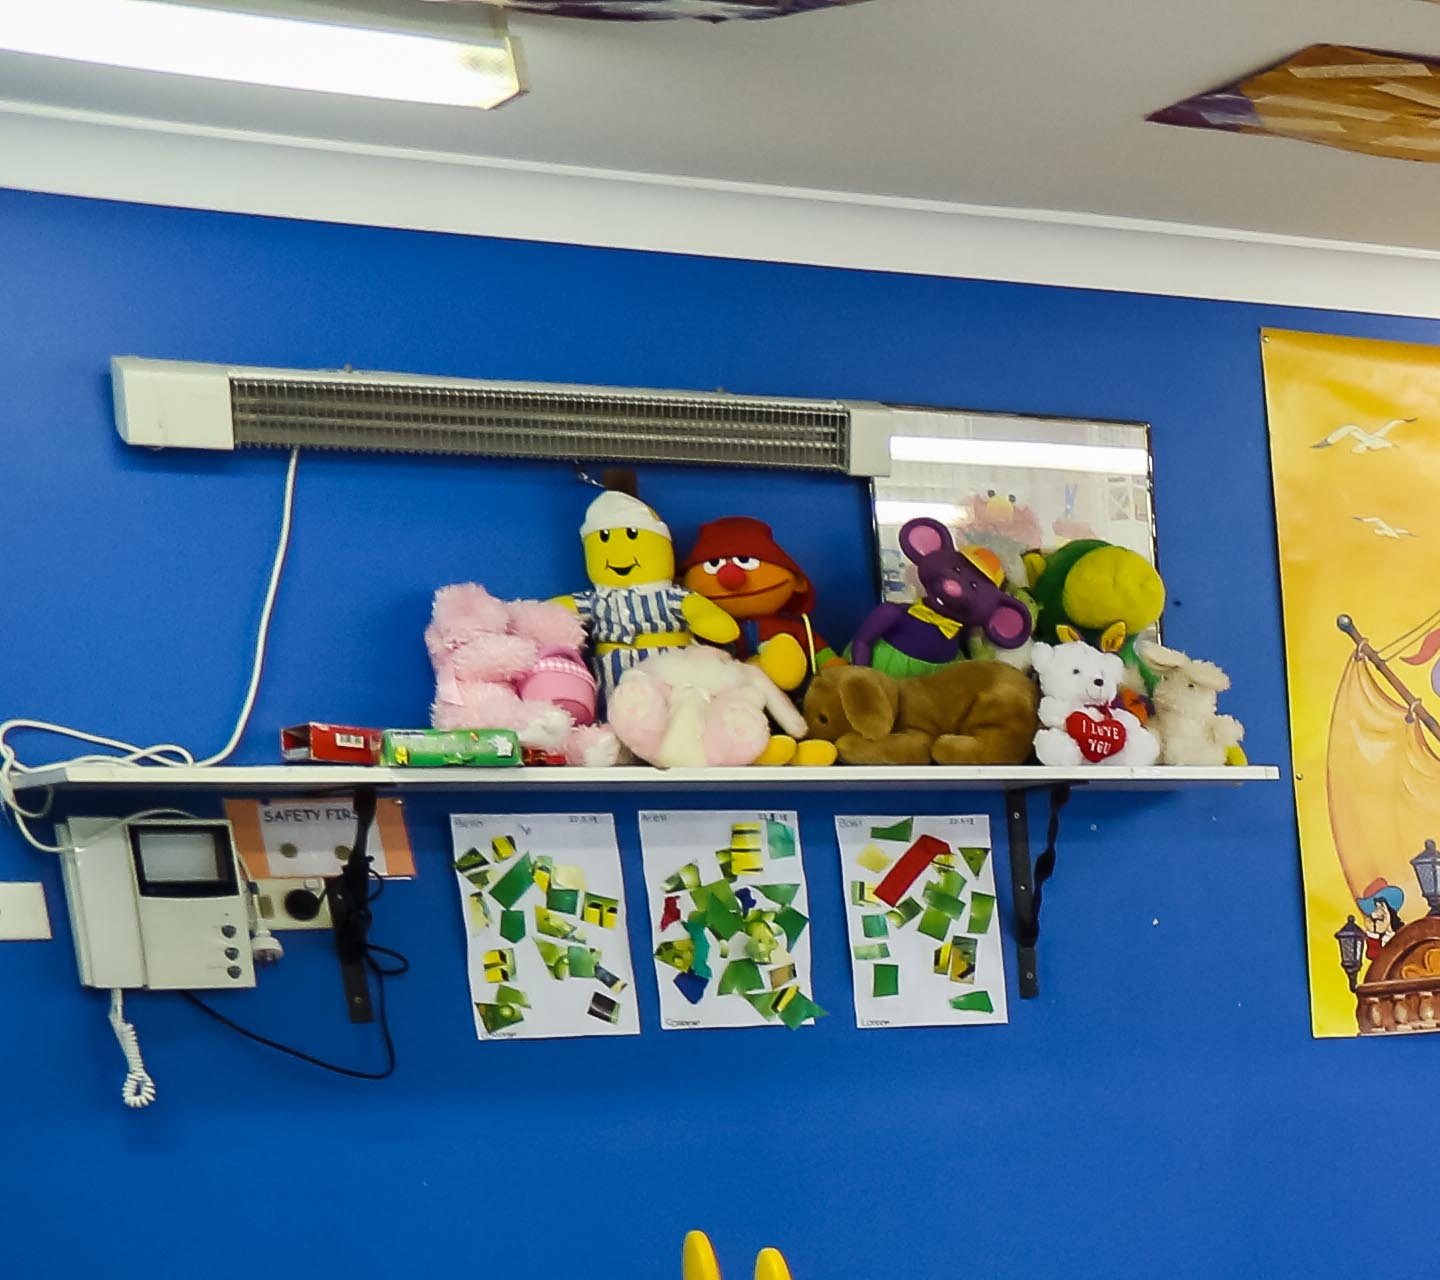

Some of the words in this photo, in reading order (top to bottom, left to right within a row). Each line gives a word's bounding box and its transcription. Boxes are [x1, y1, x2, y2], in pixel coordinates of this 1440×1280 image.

[1082, 720, 1086, 733] I
[1091, 723, 1119, 740] LOVE
[1088, 738, 1111, 755] YOU
[264, 808, 320, 822] SAFETY
[326, 808, 359, 821] FIRS
